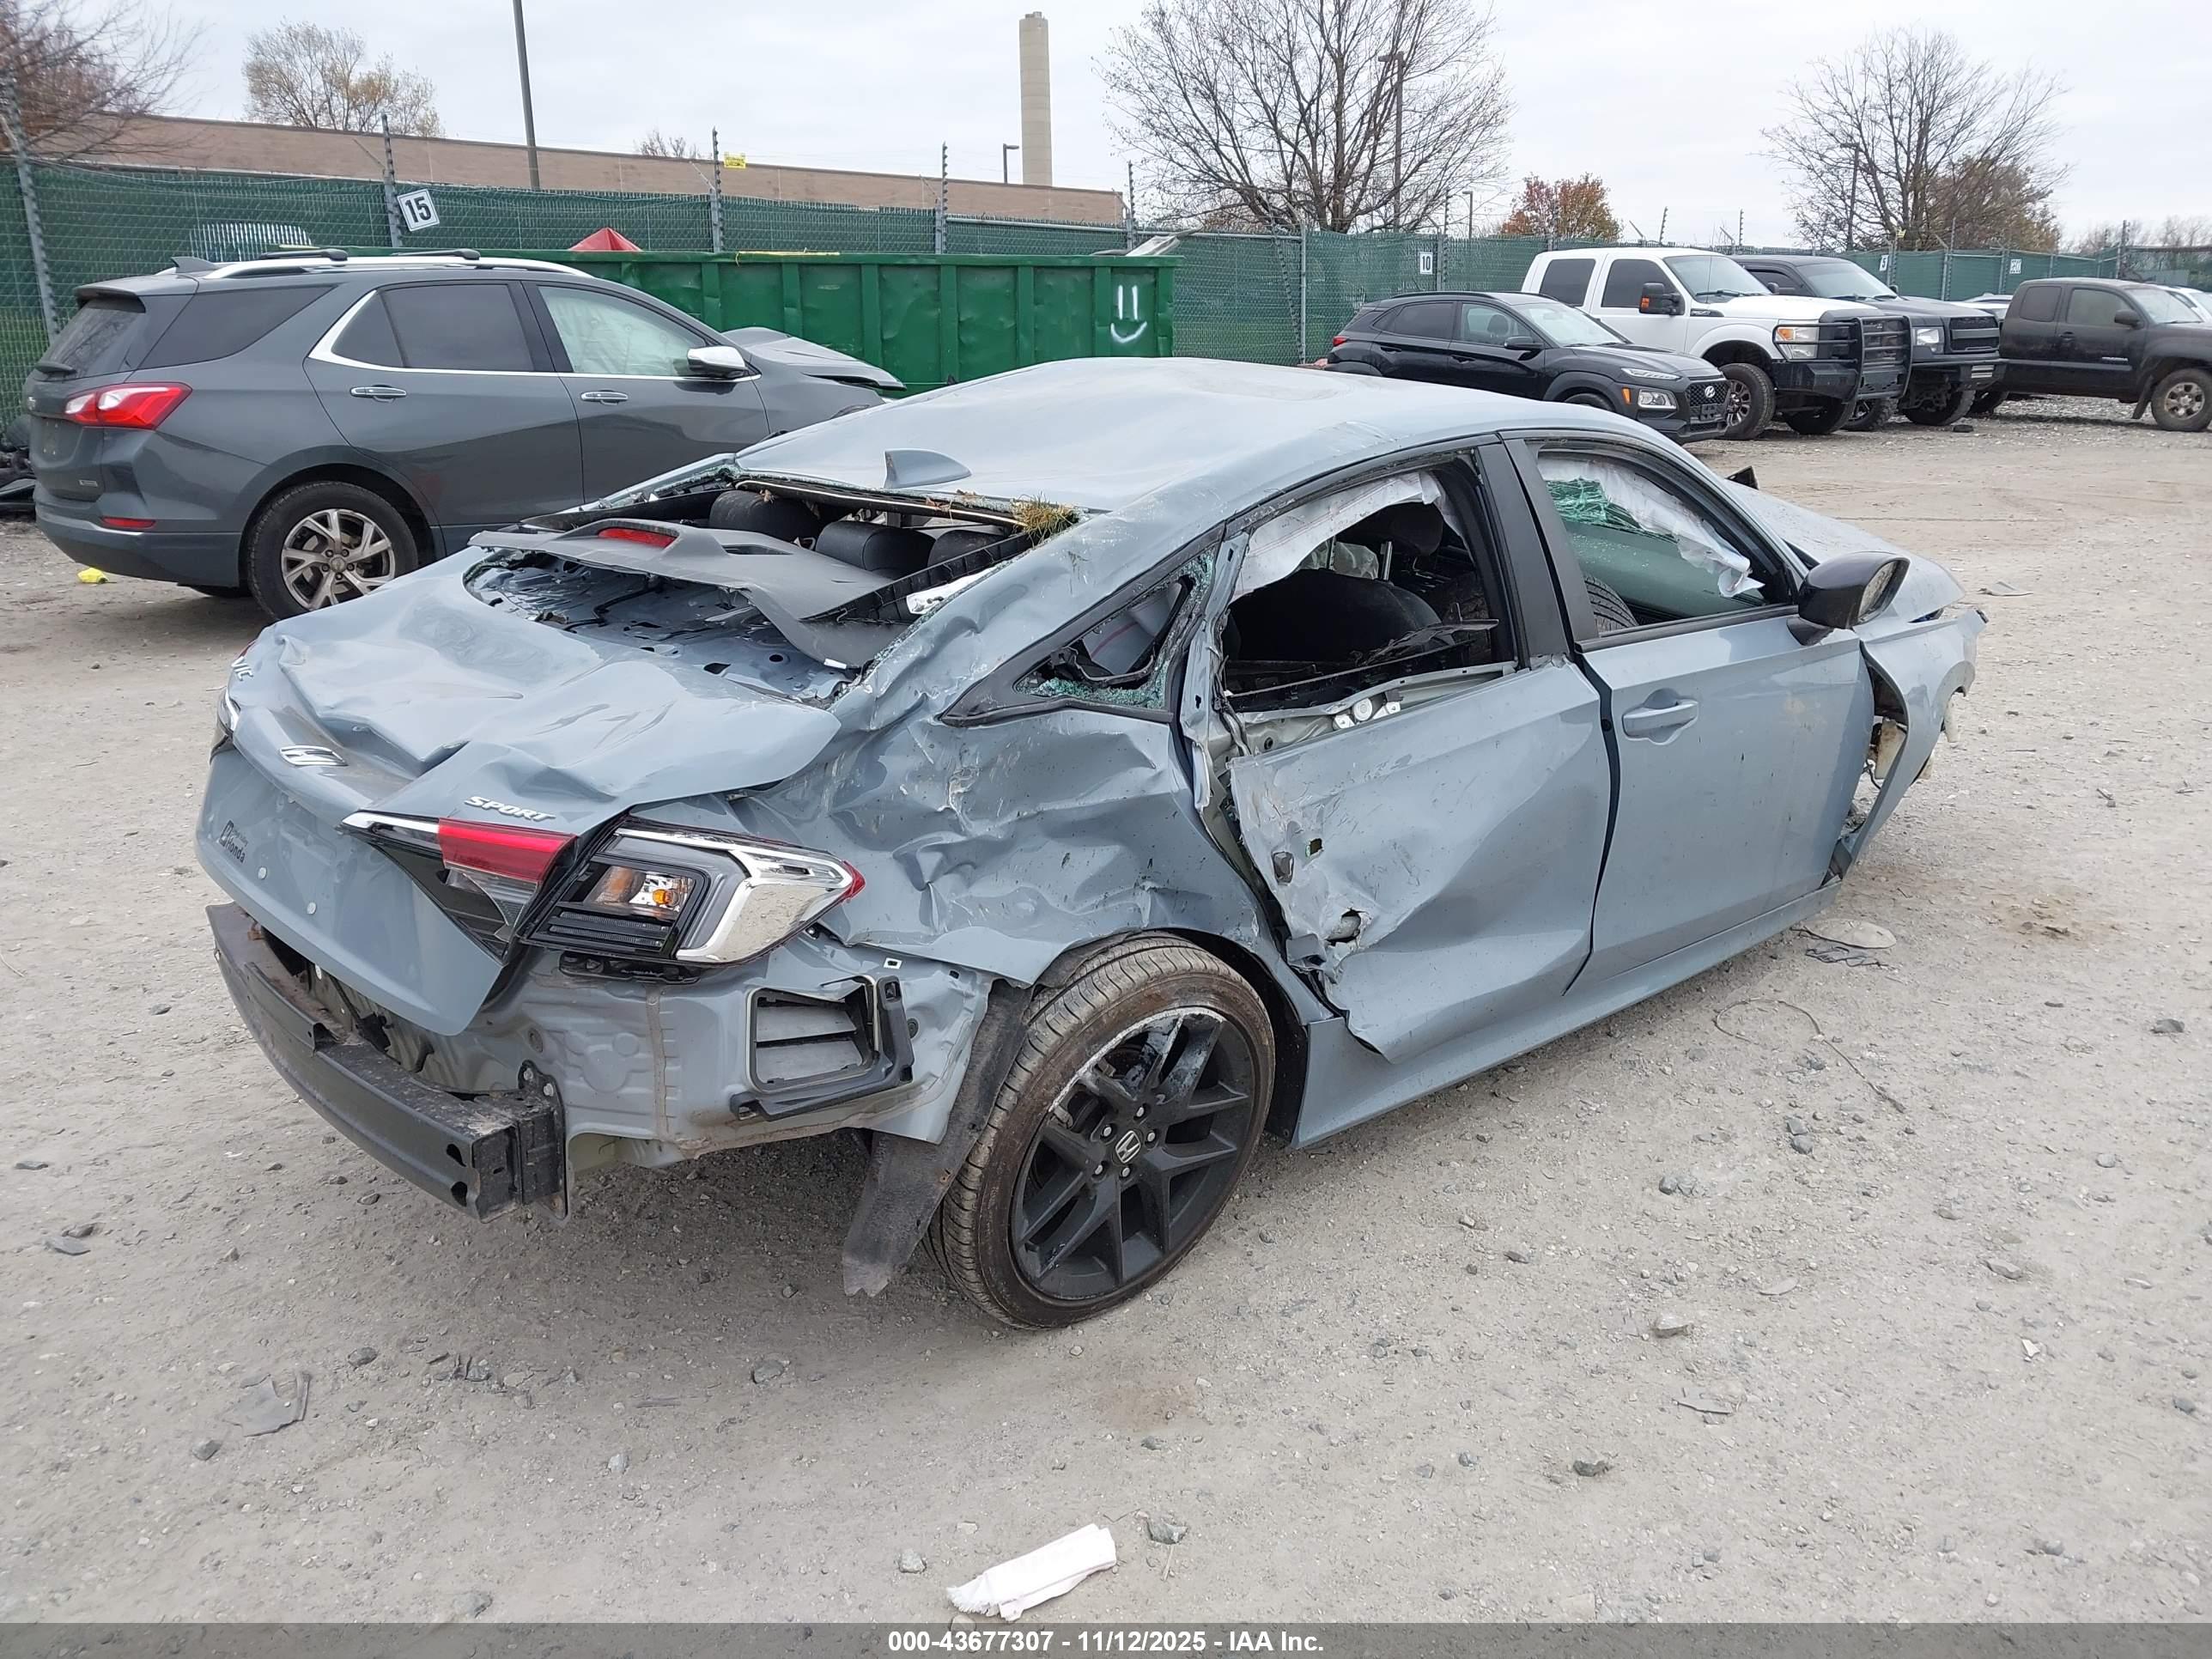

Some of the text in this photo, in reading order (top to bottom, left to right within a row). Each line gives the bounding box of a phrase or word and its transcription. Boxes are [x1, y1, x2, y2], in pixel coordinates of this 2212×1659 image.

[404, 197, 431, 223] 15
[1422, 256, 1431, 270] 10
[464, 795, 557, 822] SPORT
